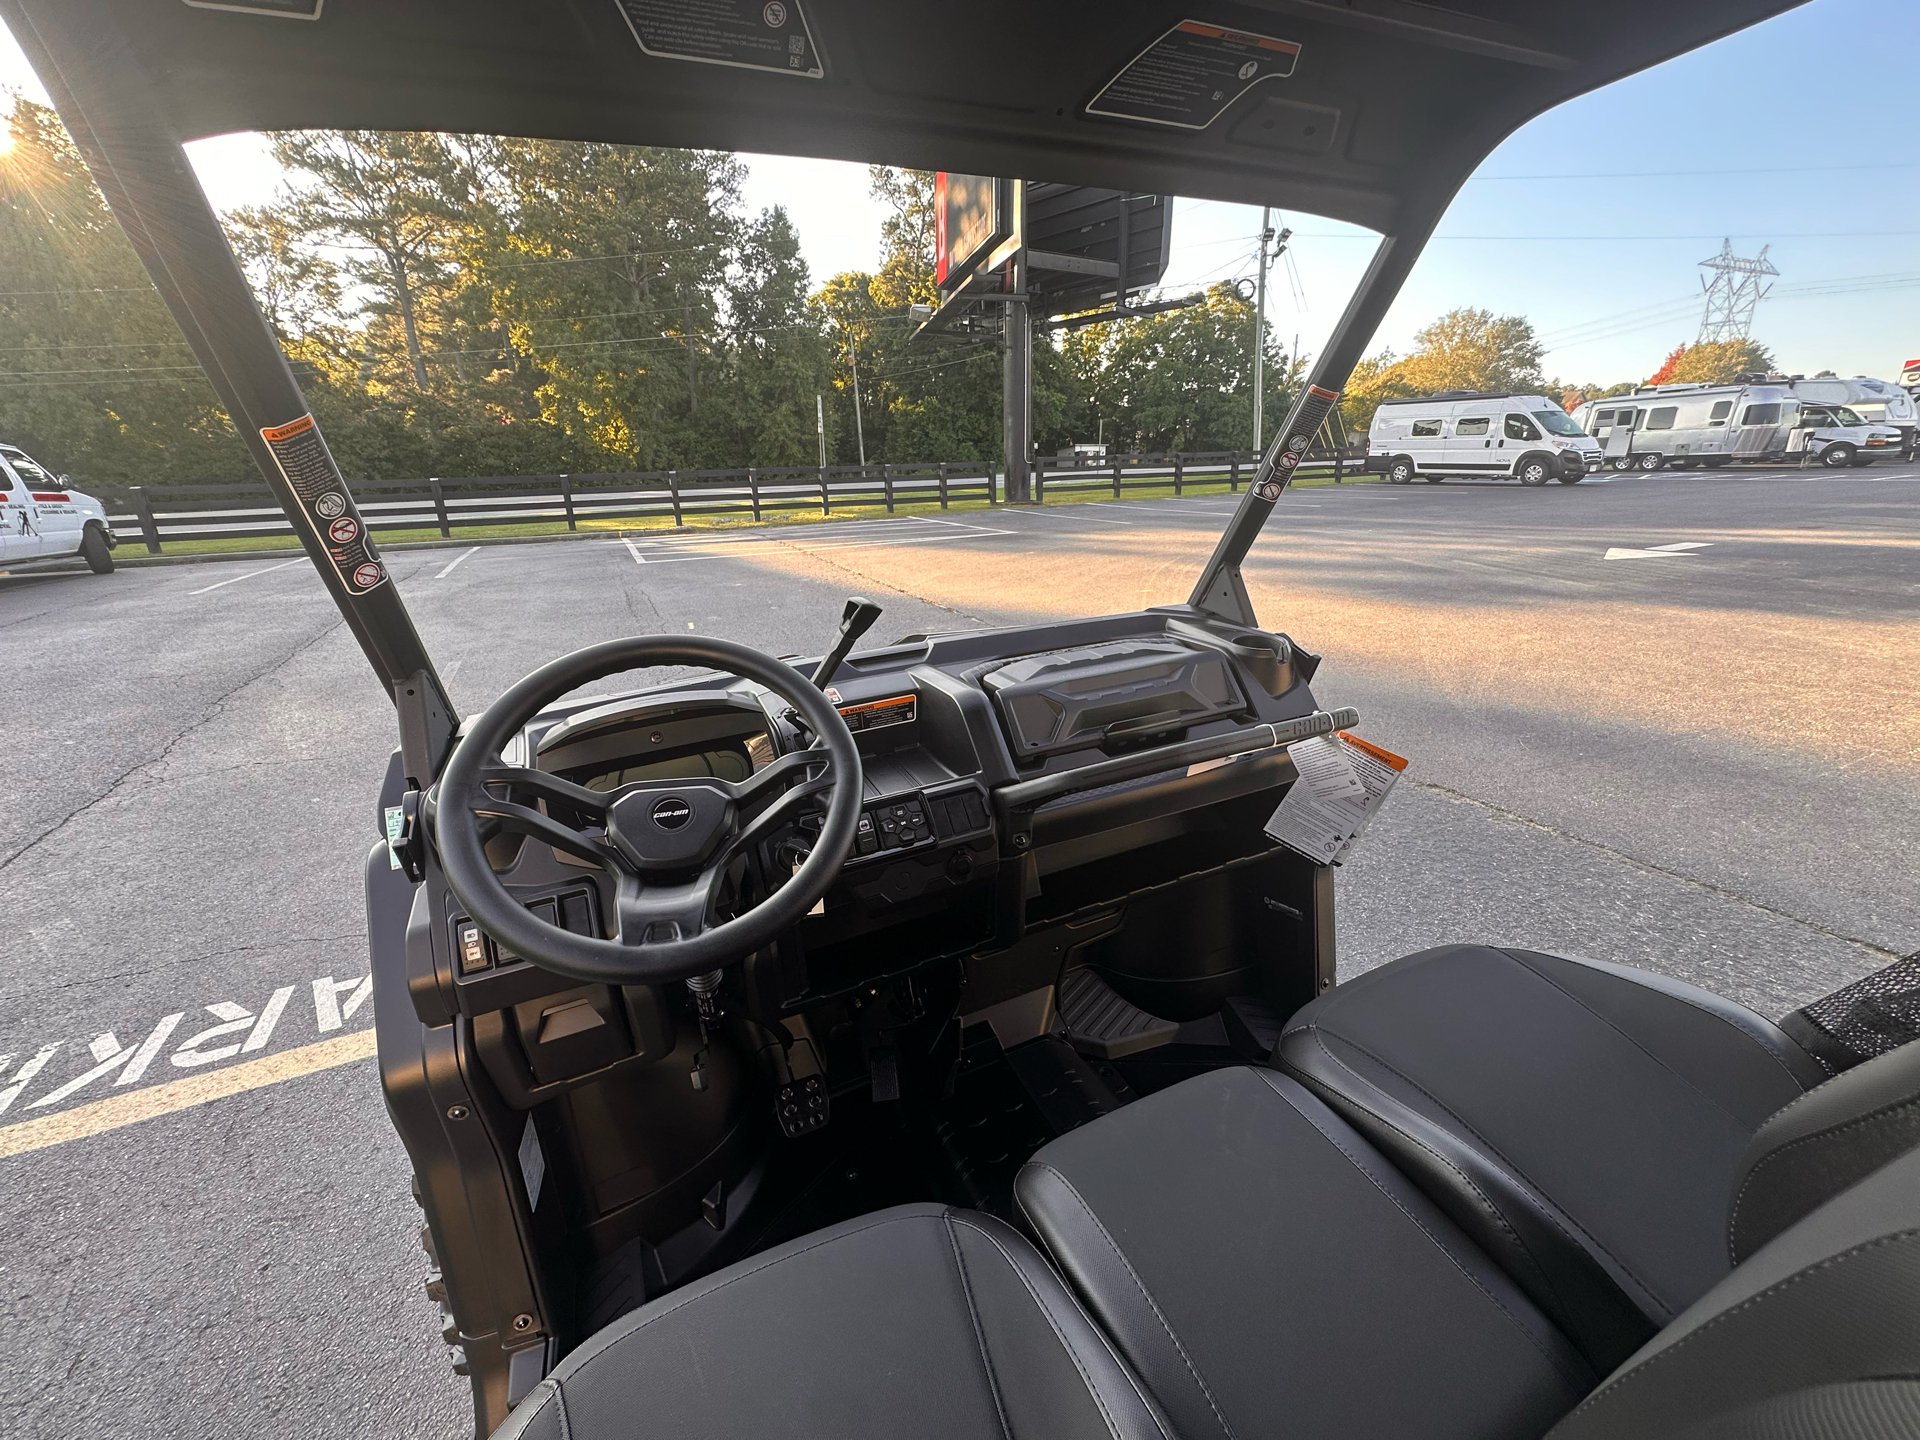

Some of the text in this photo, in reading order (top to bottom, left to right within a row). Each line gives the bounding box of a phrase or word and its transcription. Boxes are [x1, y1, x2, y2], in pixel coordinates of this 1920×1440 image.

[278, 420, 311, 438] WARNING
[849, 704, 874, 713] WARNING
[1349, 739, 1392, 765] AVERTISSEMENT
